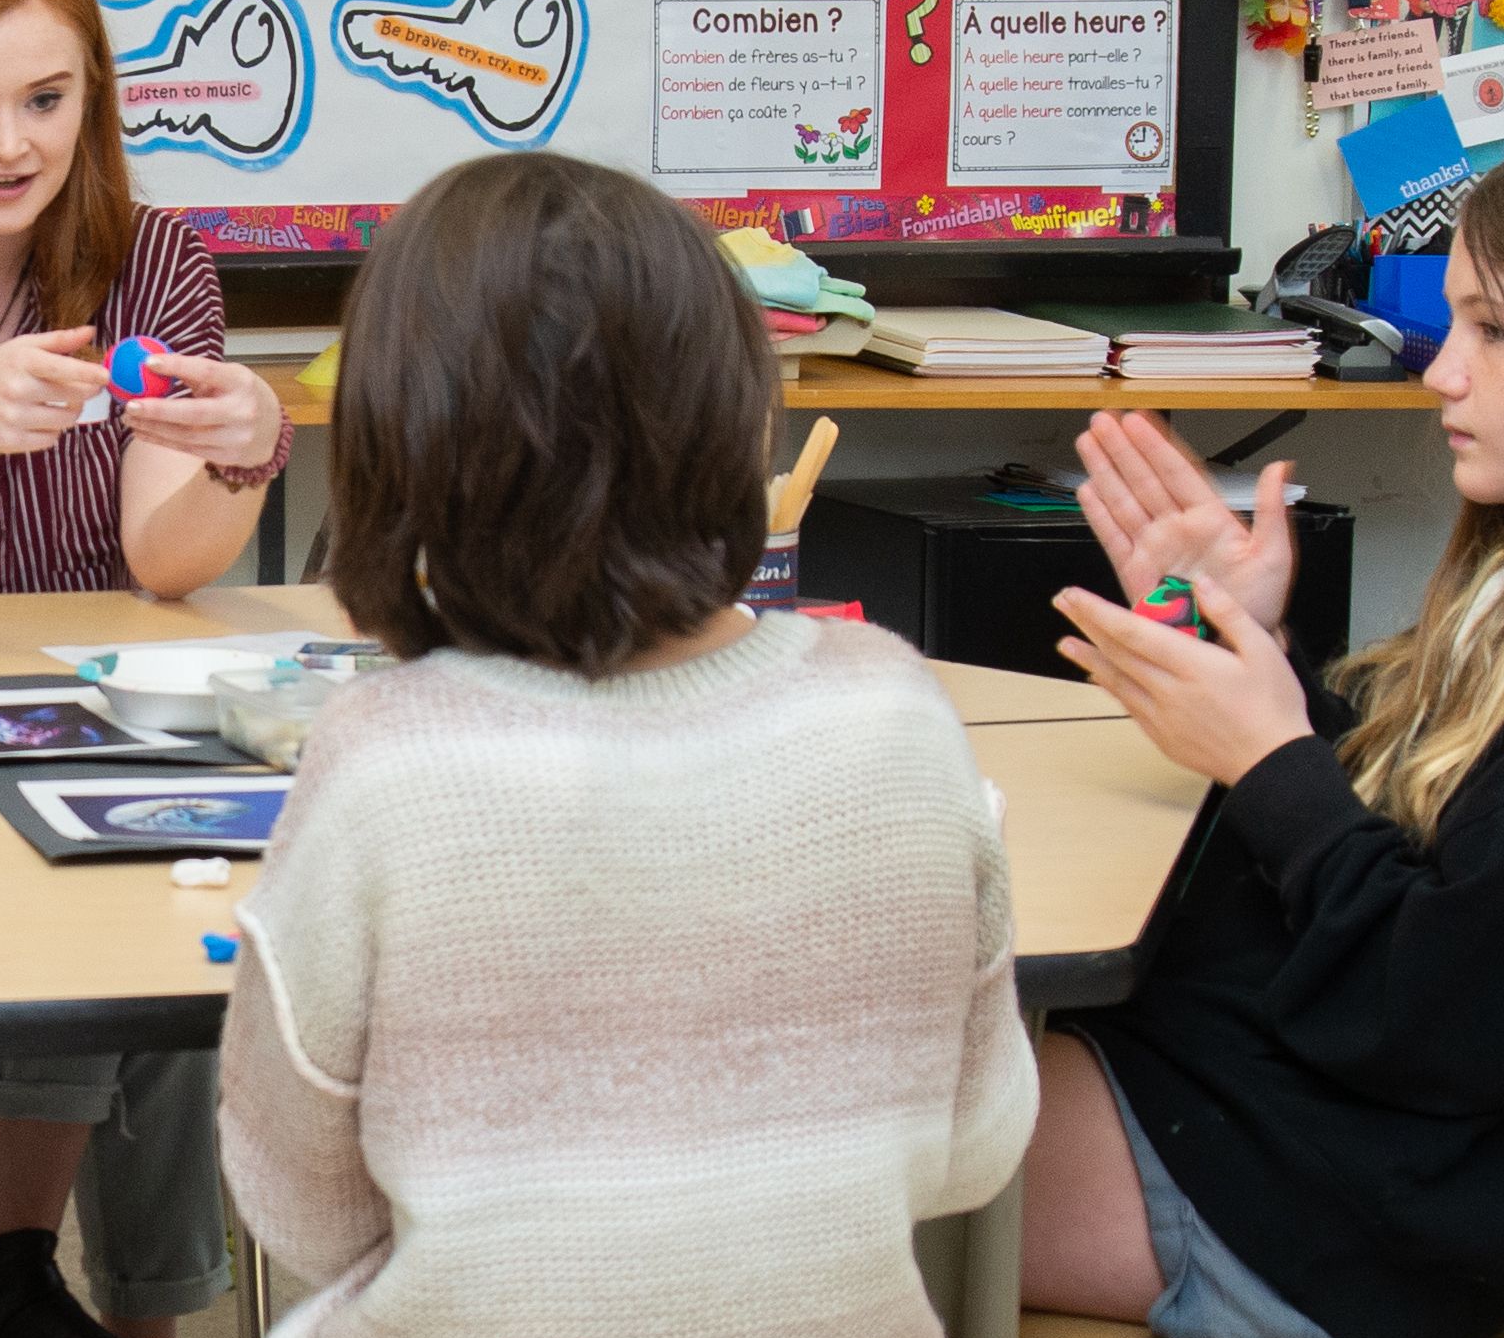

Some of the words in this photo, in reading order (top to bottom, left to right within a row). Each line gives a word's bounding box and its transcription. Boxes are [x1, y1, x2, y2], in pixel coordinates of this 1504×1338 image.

[693, 8, 820, 34] Combien
[827, 9, 843, 33] ?
[127, 86, 178, 101] Listen
[184, 85, 201, 98] to
[207, 83, 252, 97] music
[1400, 157, 1470, 198] thanks!
[901, 195, 1022, 237] Formidable!
[1012, 197, 1121, 235] Magnifique!
